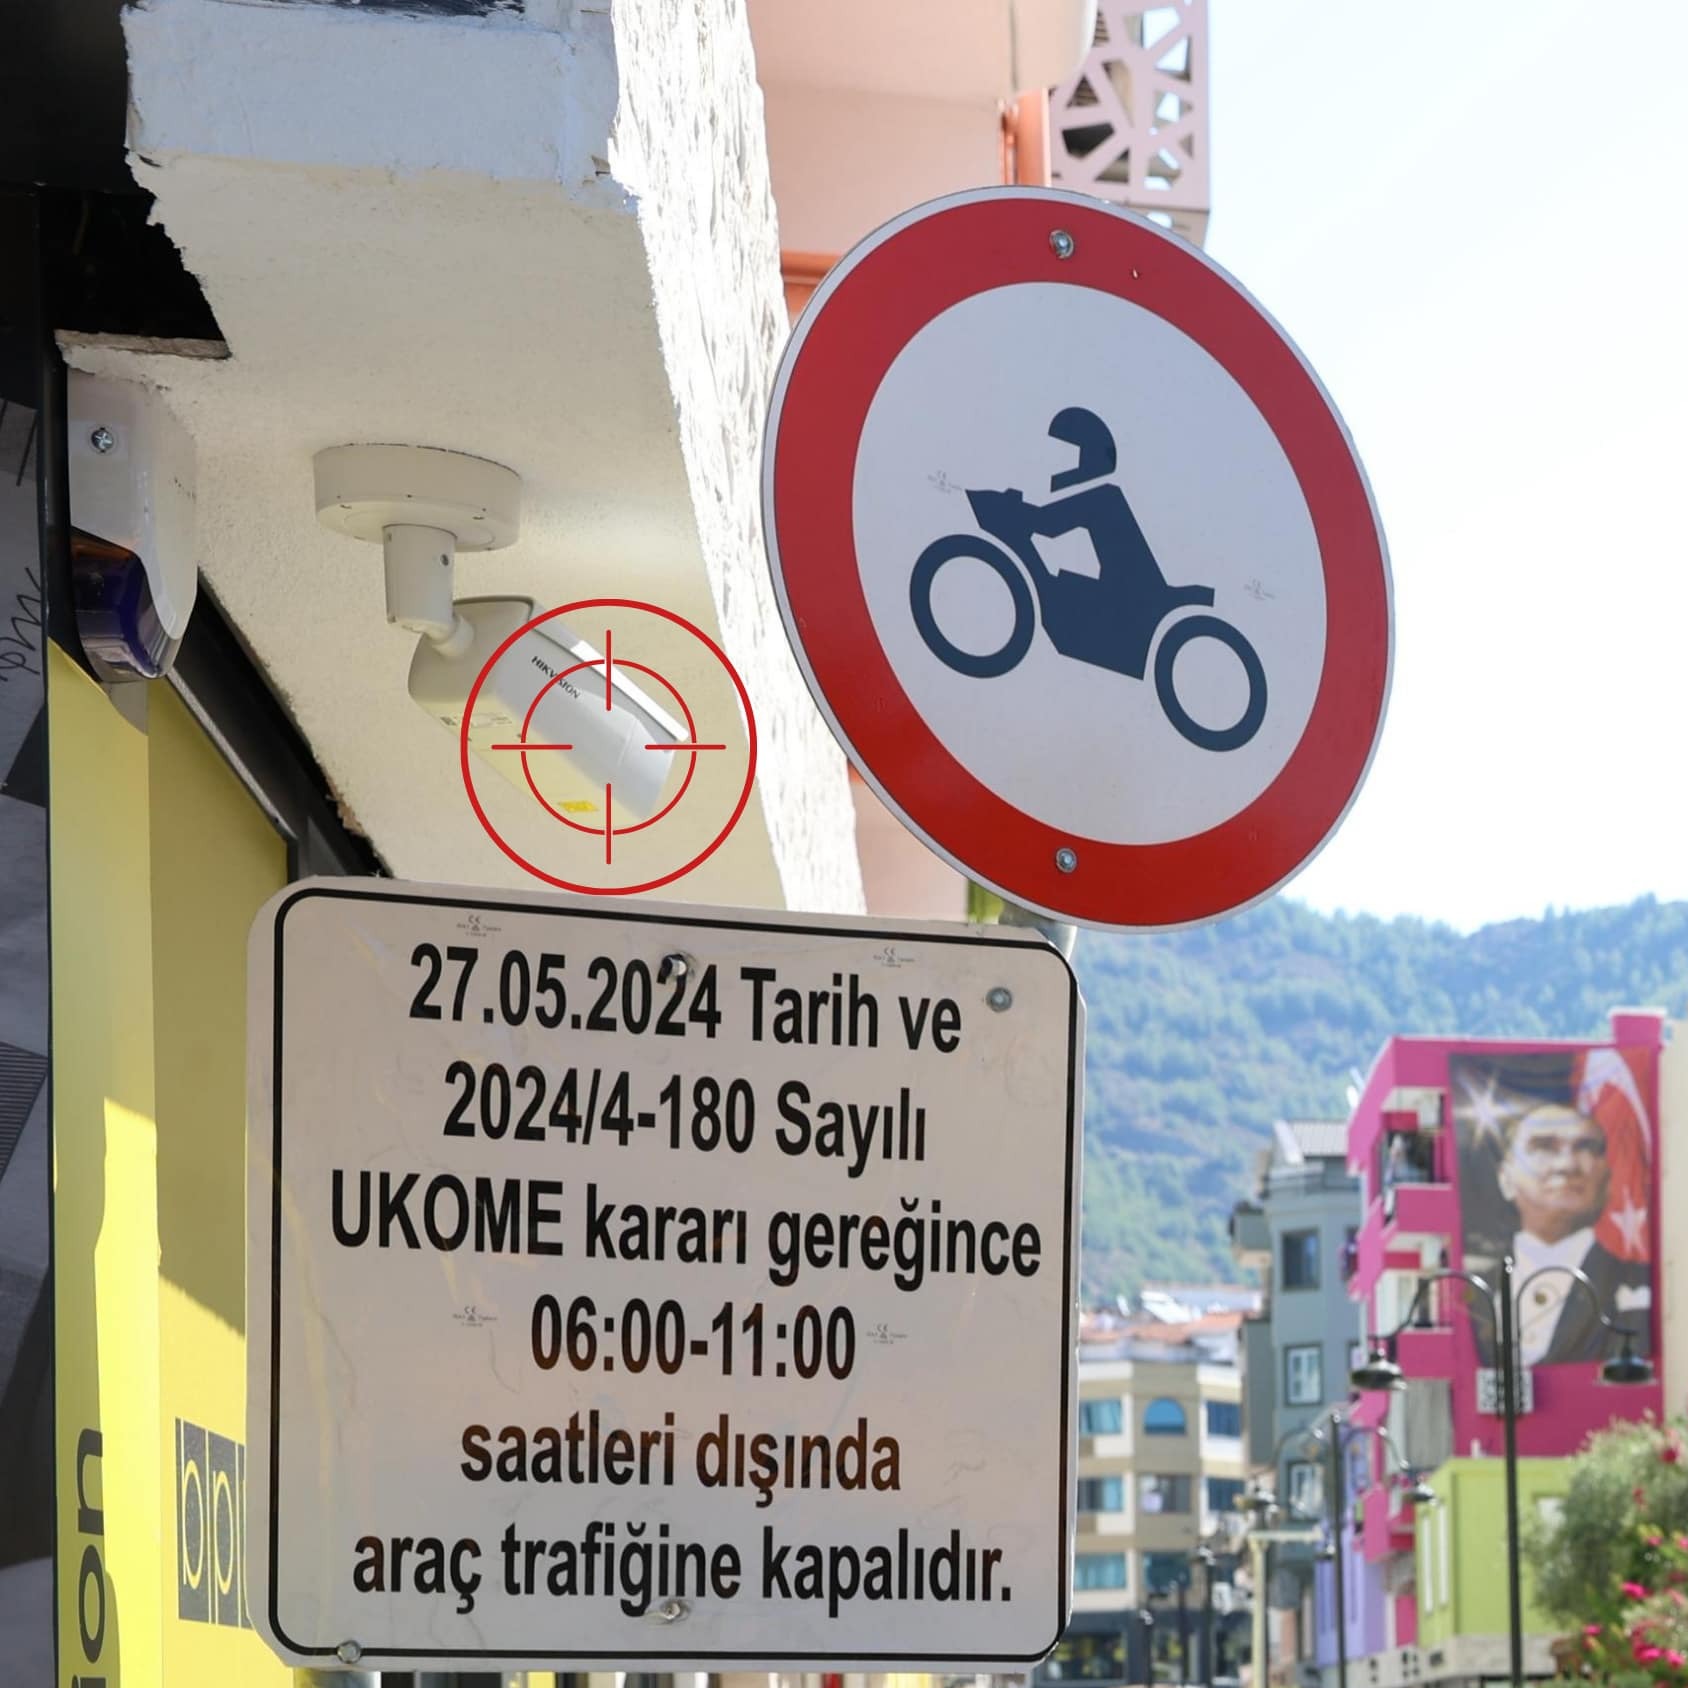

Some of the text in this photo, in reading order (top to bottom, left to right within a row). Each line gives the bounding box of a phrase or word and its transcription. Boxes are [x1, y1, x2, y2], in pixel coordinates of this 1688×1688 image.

[530, 655, 581, 700] HIKVSION
[409, 942, 962, 1054] 27.05.2024 Tarih ve
[443, 1060, 926, 1179] 2024/4-180 Sayılı
[331, 1169, 1041, 1292] UKOME kararı gereğince
[531, 1293, 856, 1381] 06:00-11:00
[460, 1409, 901, 1509] saatleri dışında
[353, 1520, 1011, 1619] araç trafiğine kapalıdır.
